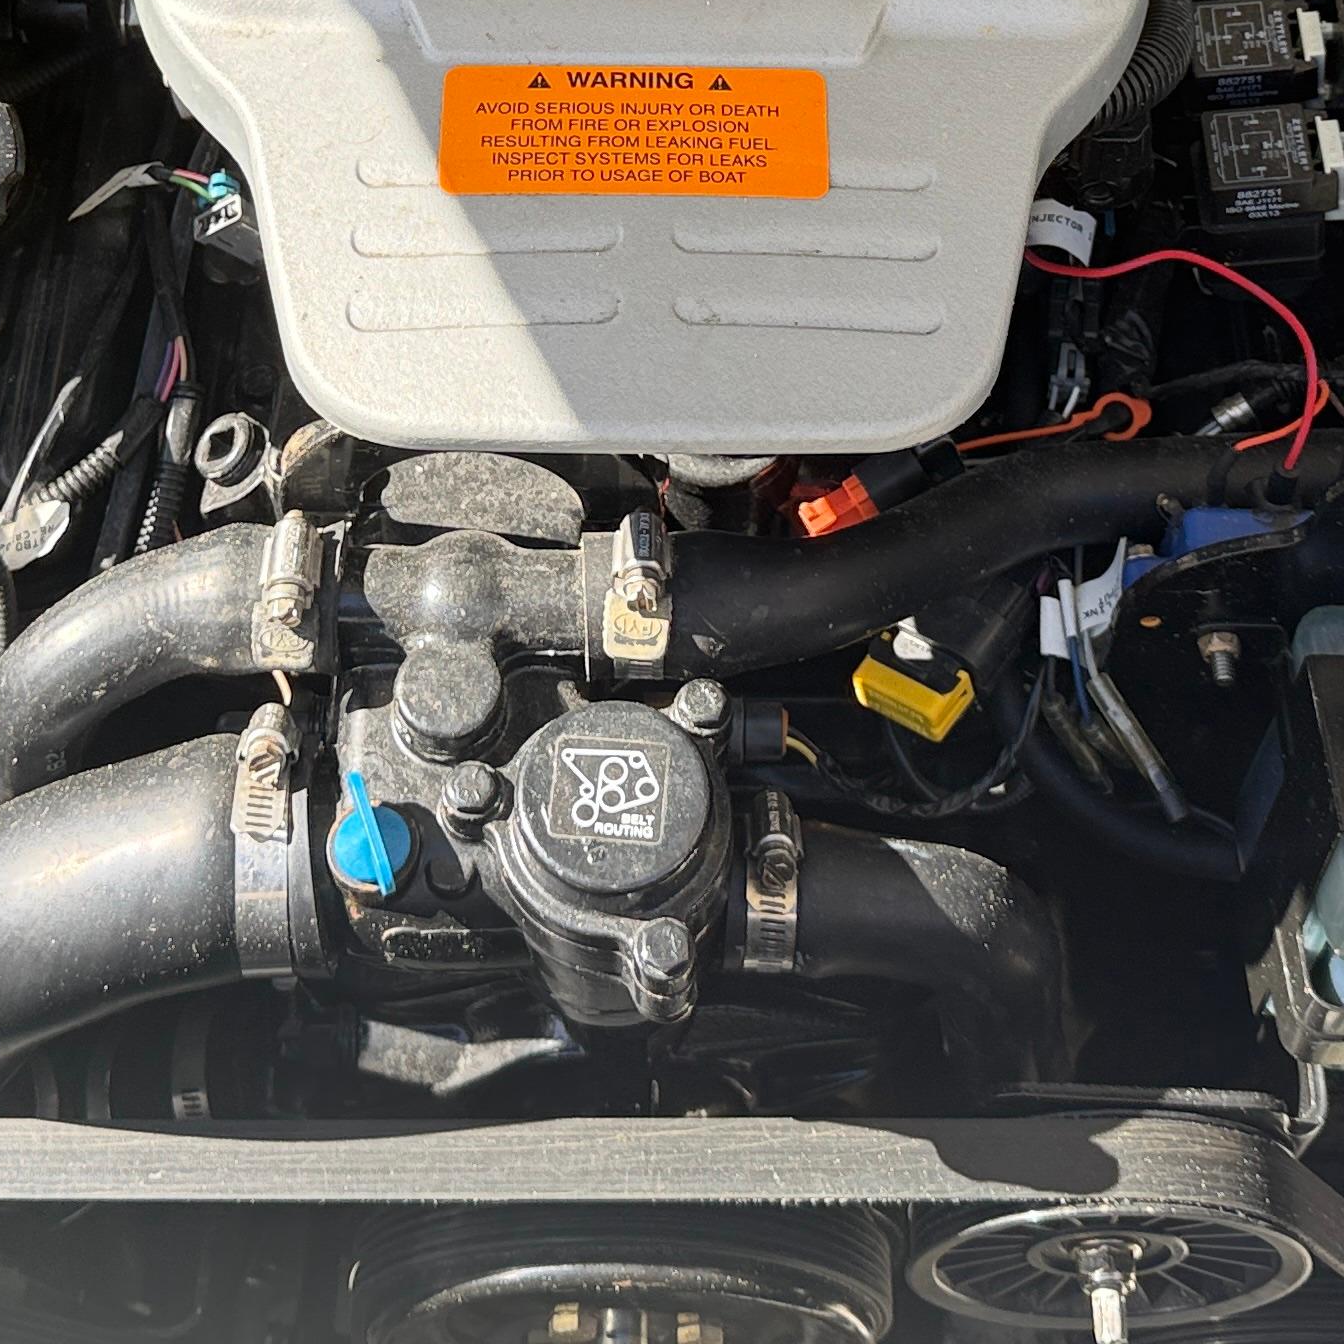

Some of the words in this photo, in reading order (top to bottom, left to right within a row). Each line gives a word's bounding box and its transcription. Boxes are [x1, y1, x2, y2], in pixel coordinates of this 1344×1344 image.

[566, 72, 695, 90] WARNING
[476, 102, 528, 115] AVOID
[535, 102, 616, 116] SERIOUS
[620, 103, 685, 117] INJURY
[689, 104, 717, 117] OR
[721, 104, 780, 118] DEATH
[511, 119, 563, 132] FROM
[568, 119, 609, 132] FIRE
[613, 119, 642, 132] OR
[646, 120, 750, 134] EXPLOSION
[480, 135, 582, 149] RESULTING
[587, 136, 640, 149] FROM
[645, 136, 723, 150] LEAKING
[1291, 118, 1309, 165] ZETTLER
[492, 152, 570, 166] INSPECT
[575, 152, 662, 167] SYSTEMS
[666, 153, 705, 167] FOR
[709, 153, 768, 168] LEAKS
[508, 170, 564, 183] PRIOR
[570, 170, 595, 182] TO
[599, 170, 663, 183] USAGE
[668, 170, 694, 183] OF
[699, 171, 748, 184] BOAT
[1237, 188, 1282, 200] 882751
[621, 814, 655, 827] BELT
[594, 821, 654, 839] ROUTING
